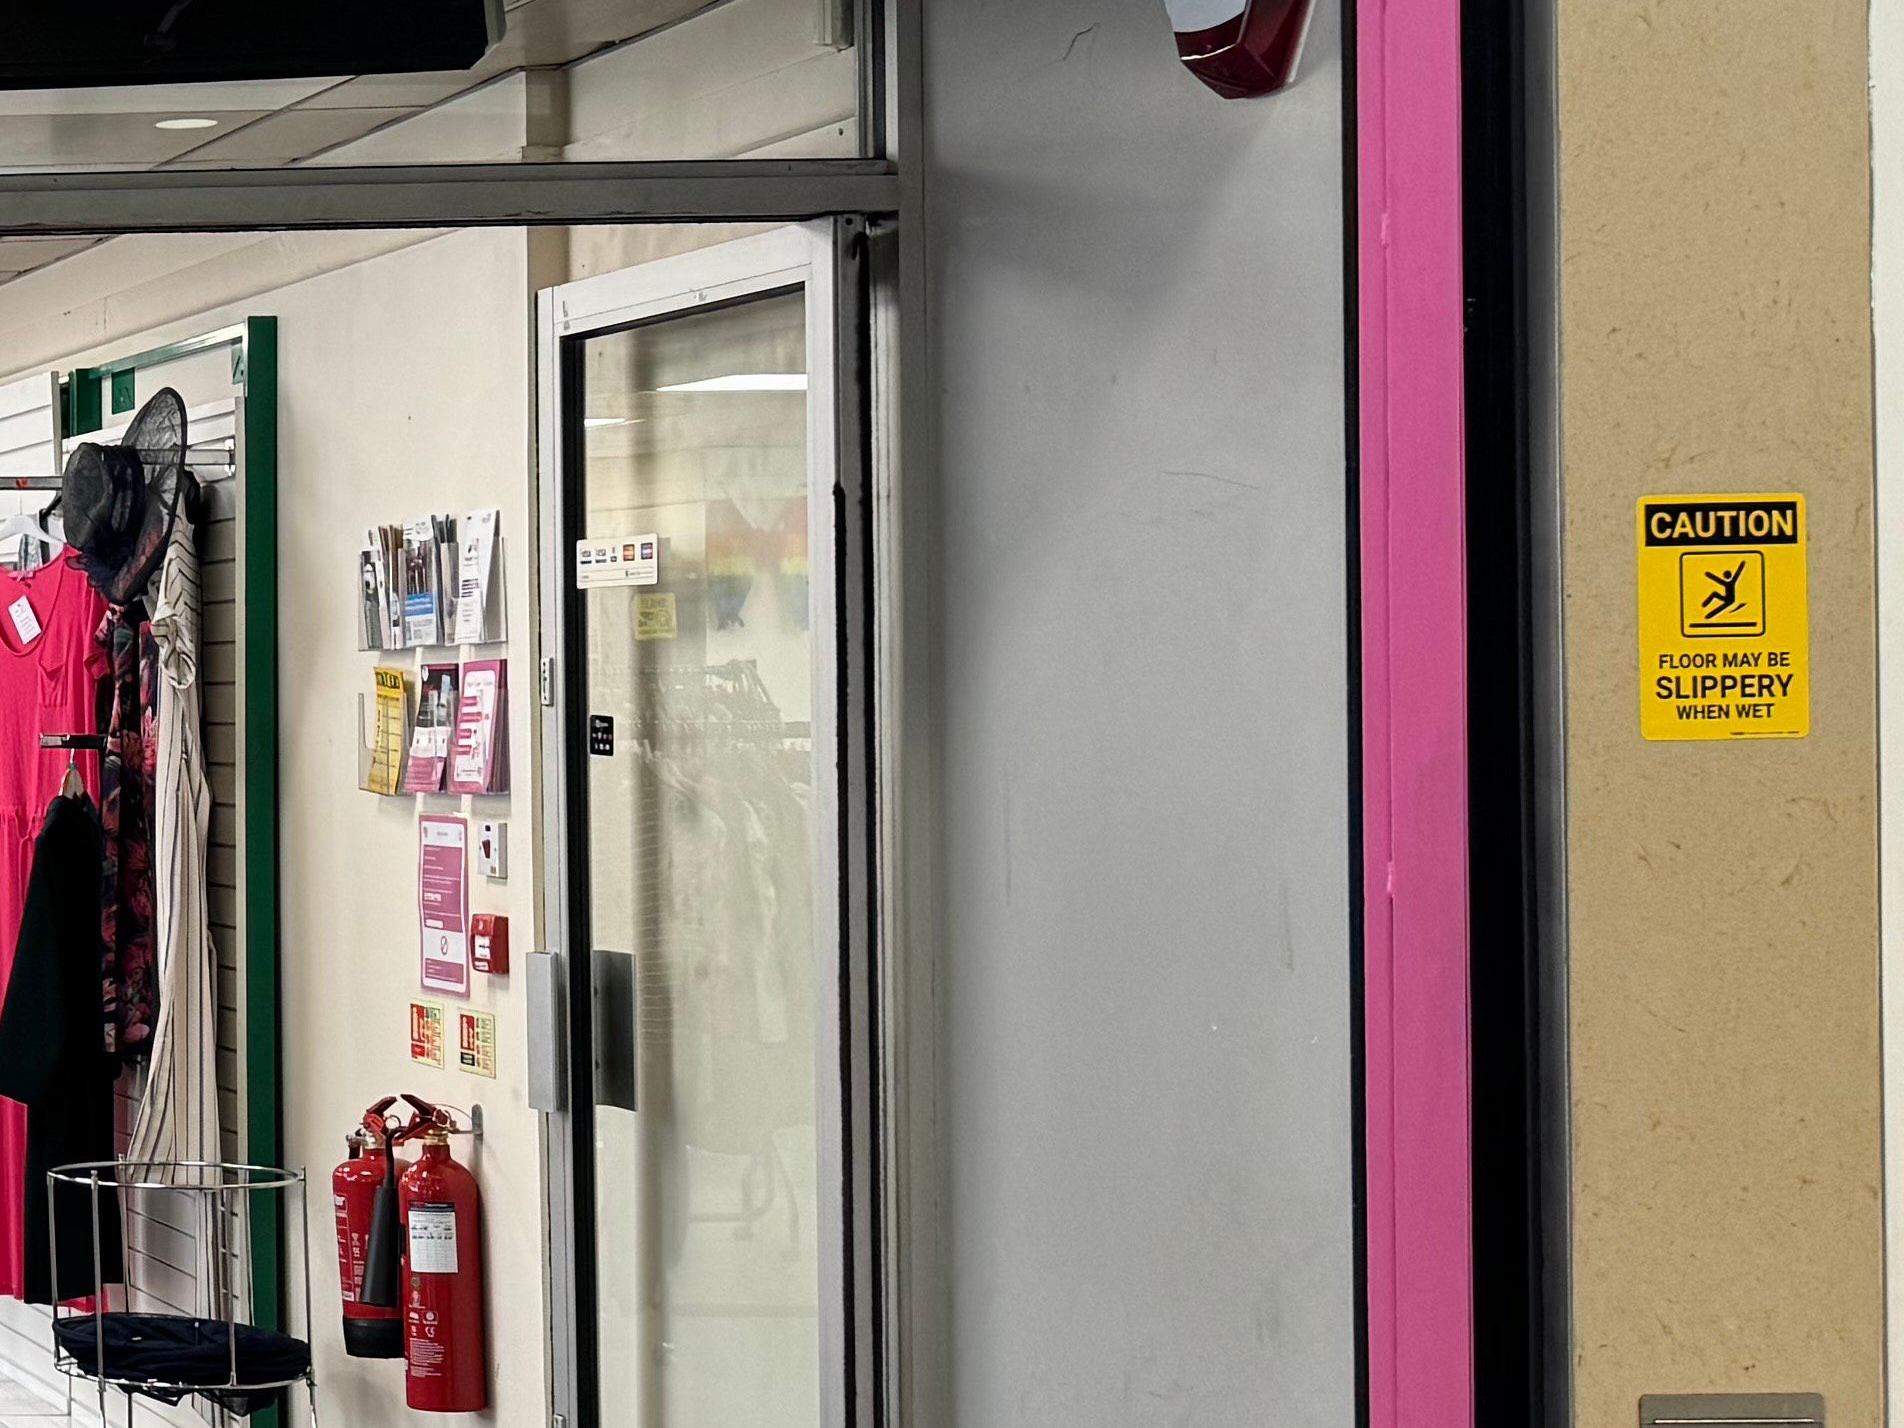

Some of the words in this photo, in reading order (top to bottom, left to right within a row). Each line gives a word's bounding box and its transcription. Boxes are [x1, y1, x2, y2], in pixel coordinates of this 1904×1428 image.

[1650, 510, 1794, 539] CAUTION
[1658, 653, 1717, 670] FLOOR
[1722, 652, 1762, 669] MAY
[1767, 652, 1791, 668] BE
[1655, 674, 1794, 700] SLIPPERY
[1676, 703, 1730, 720] WHEN
[1735, 703, 1775, 719] WET
